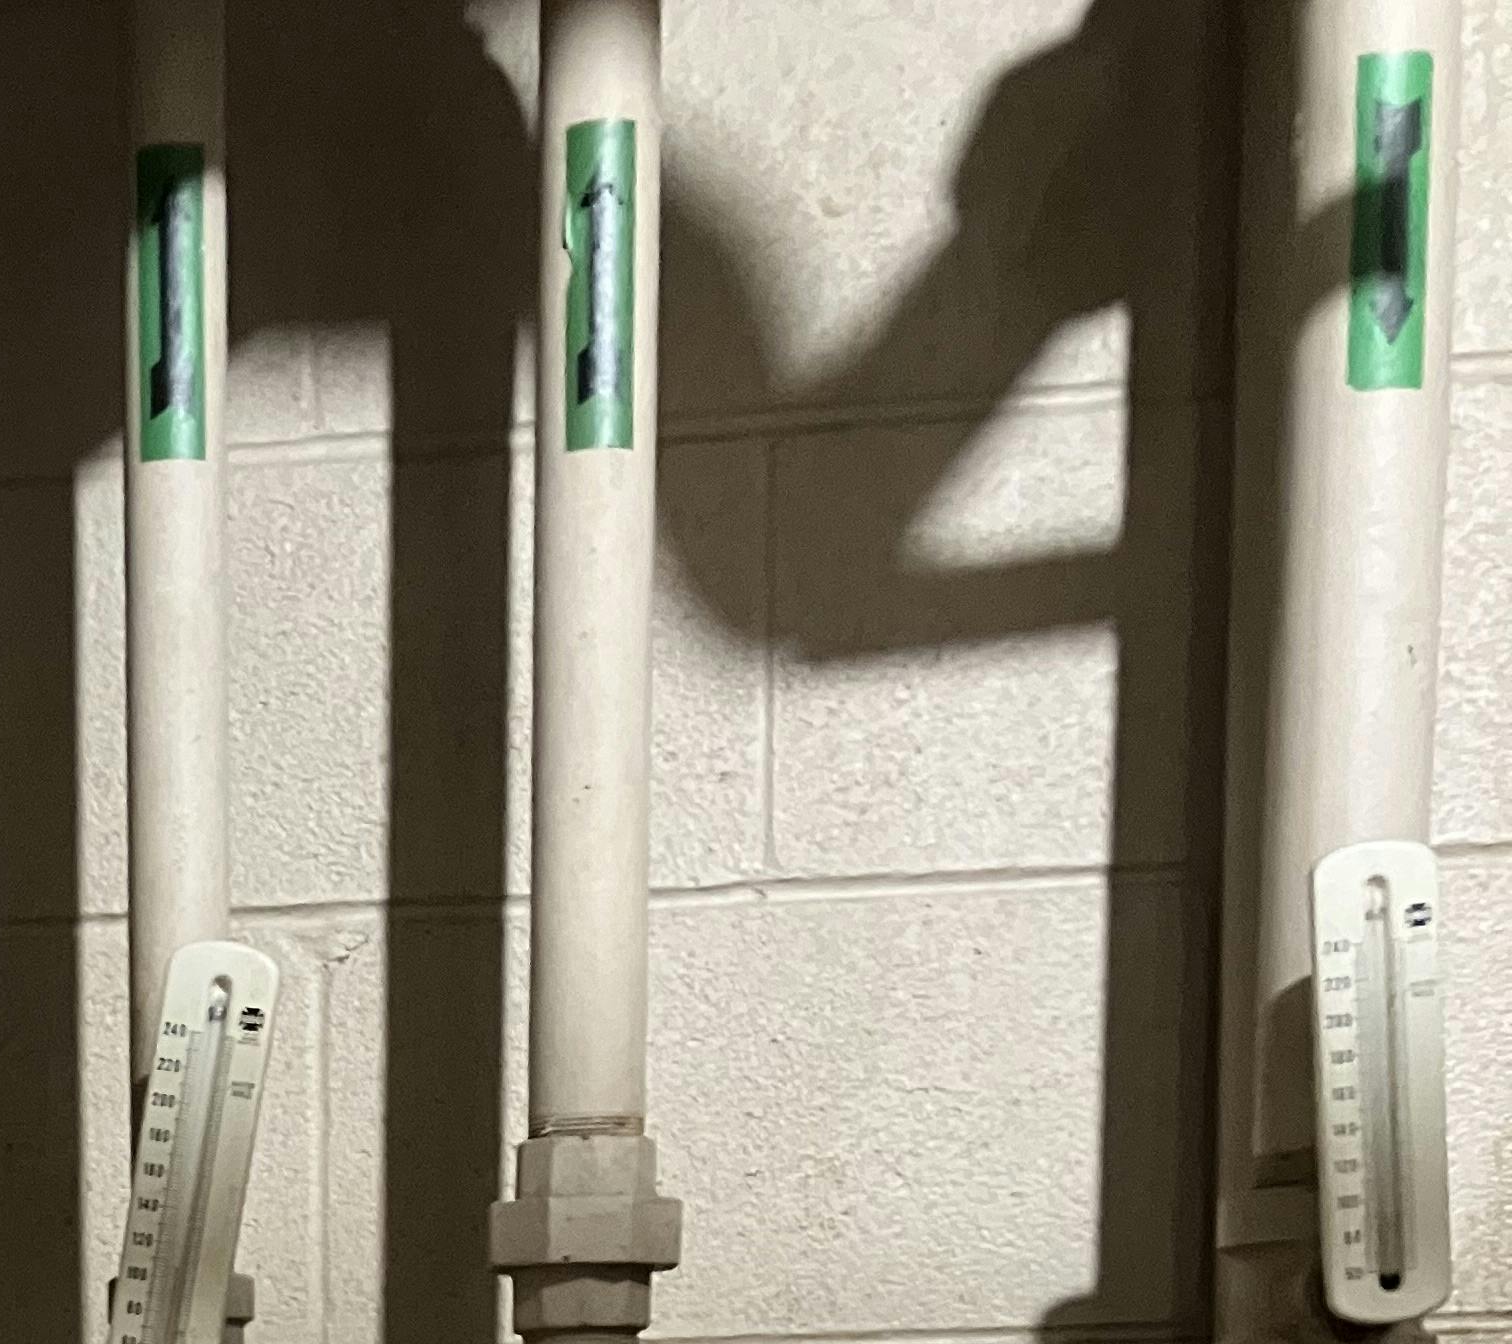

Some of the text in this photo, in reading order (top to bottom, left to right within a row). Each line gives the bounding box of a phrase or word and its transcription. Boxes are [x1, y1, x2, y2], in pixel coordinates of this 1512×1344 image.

[163, 1021, 187, 1037] 240
[156, 1057, 181, 1073] 220
[151, 1092, 176, 1108] 200
